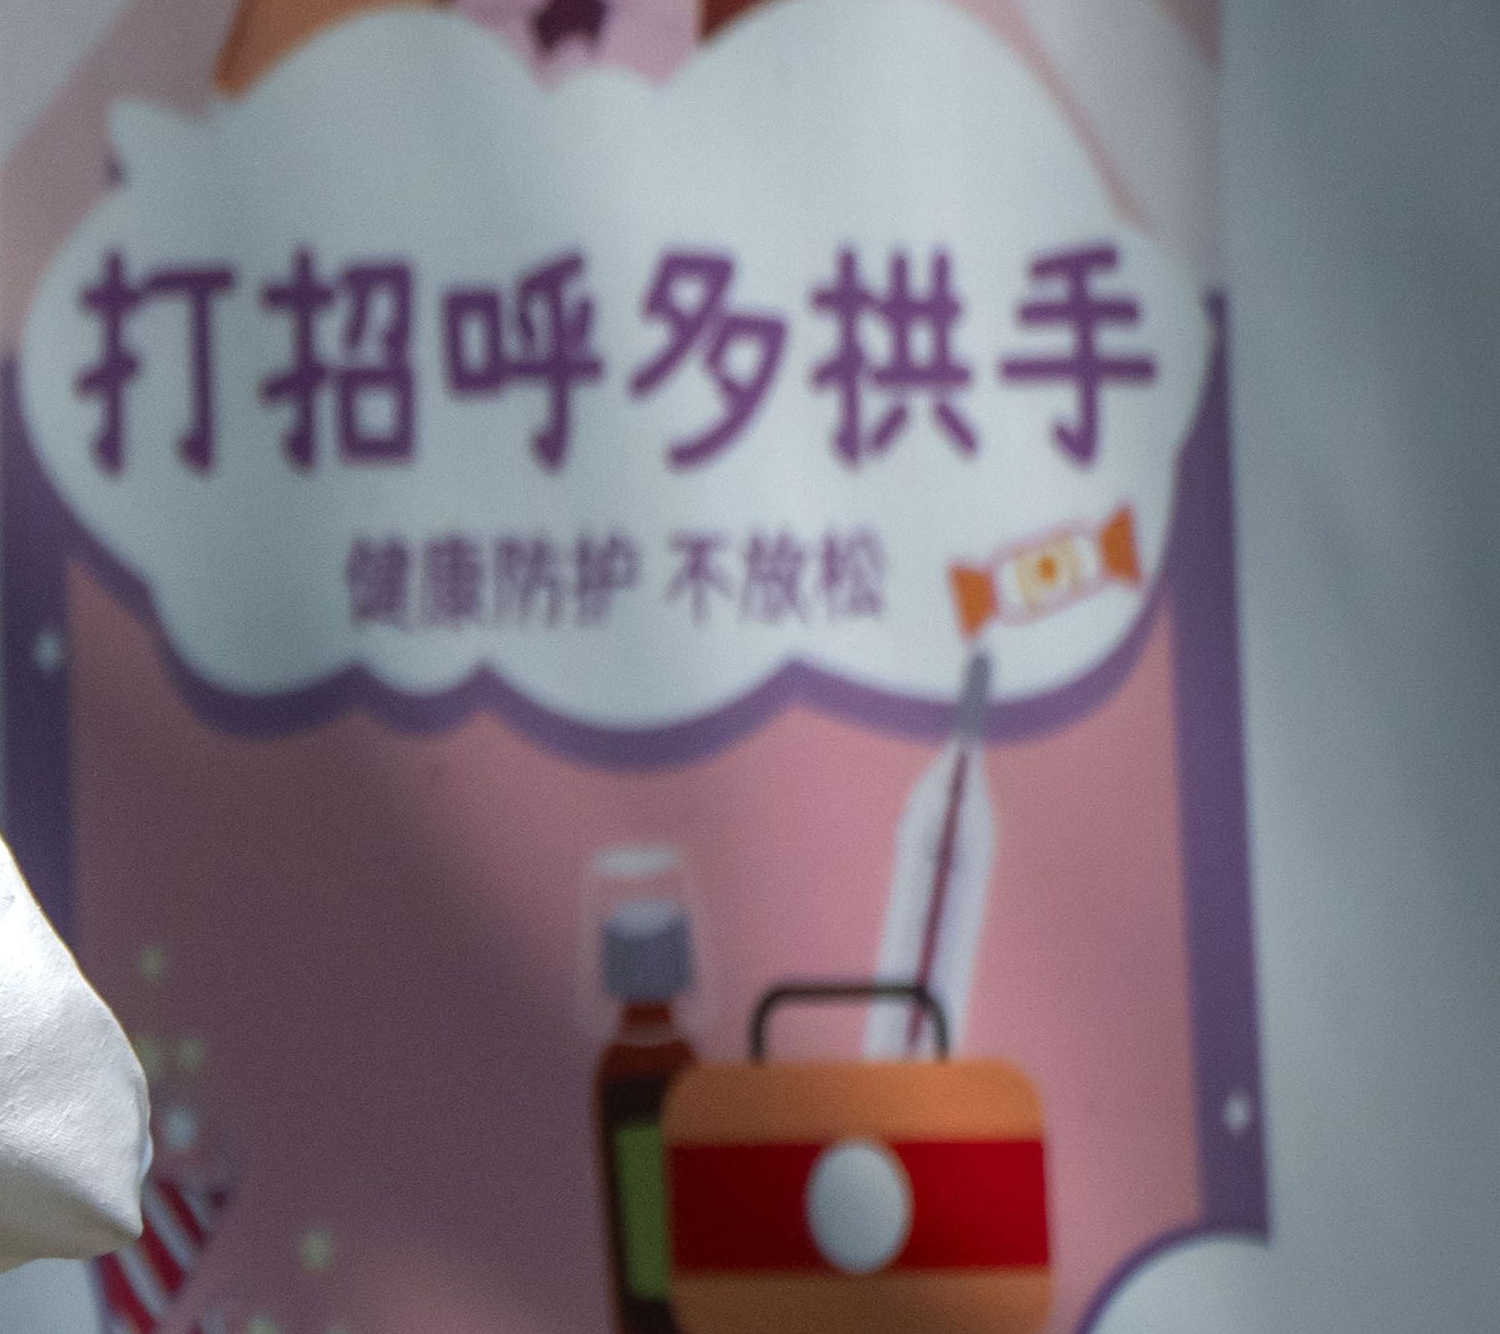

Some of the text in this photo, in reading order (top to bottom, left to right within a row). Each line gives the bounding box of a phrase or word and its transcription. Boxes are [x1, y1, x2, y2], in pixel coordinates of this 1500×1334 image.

[74, 243, 1157, 473] 打招呼多拱手
